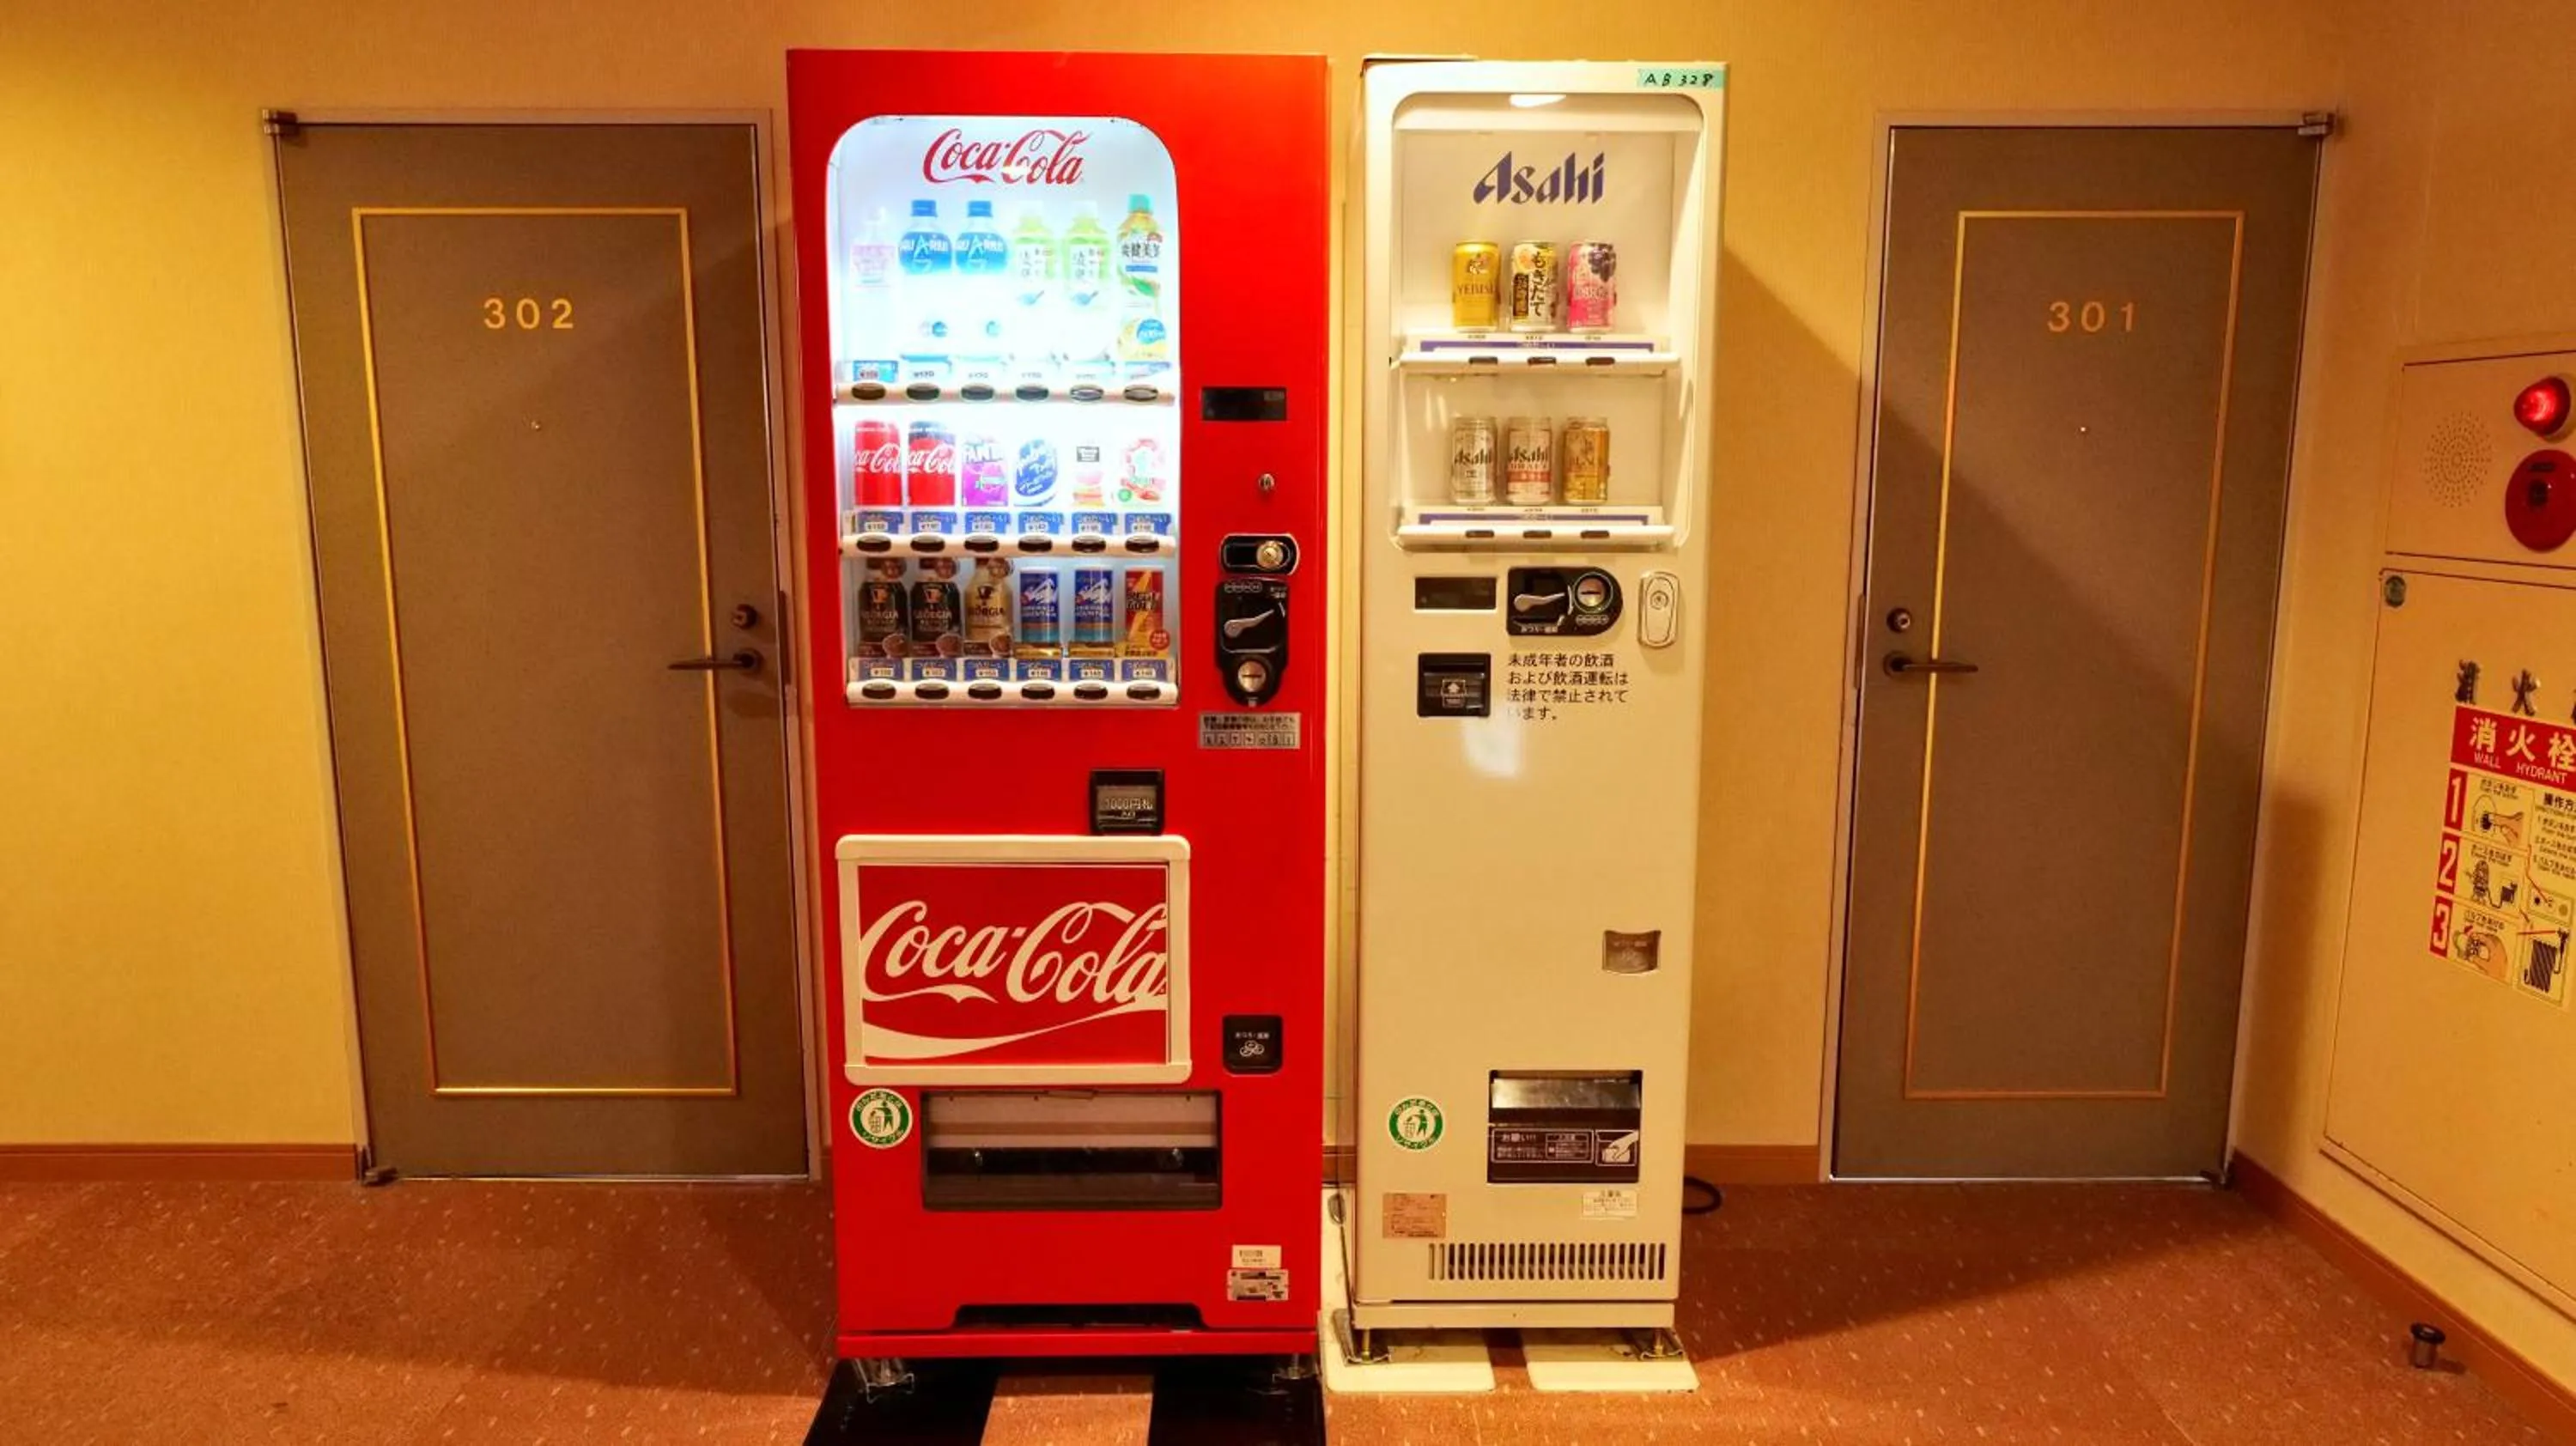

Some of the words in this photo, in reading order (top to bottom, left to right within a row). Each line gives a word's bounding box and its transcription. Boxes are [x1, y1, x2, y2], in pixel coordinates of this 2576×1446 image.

[922, 128, 1094, 185] Coca-Cola
[1473, 150, 1605, 205] Asahi
[483, 298, 574, 329] 302
[2047, 301, 2135, 332] 301
[1508, 653, 1614, 668] 未成年者の飲酒
[1508, 671, 1629, 686] および飲酒運転は
[1507, 690, 1630, 704] 法律で禁止されて
[2469, 717, 2576, 772] 消火栓
[2474, 751, 2501, 769] WALL
[2517, 762, 2567, 784] HYDRANT
[2451, 777, 2462, 823] 1
[2543, 792, 2576, 814] 操作方
[2439, 839, 2456, 887] 2
[2433, 903, 2449, 950] 3
[859, 900, 1168, 1004] Coca-Cola
